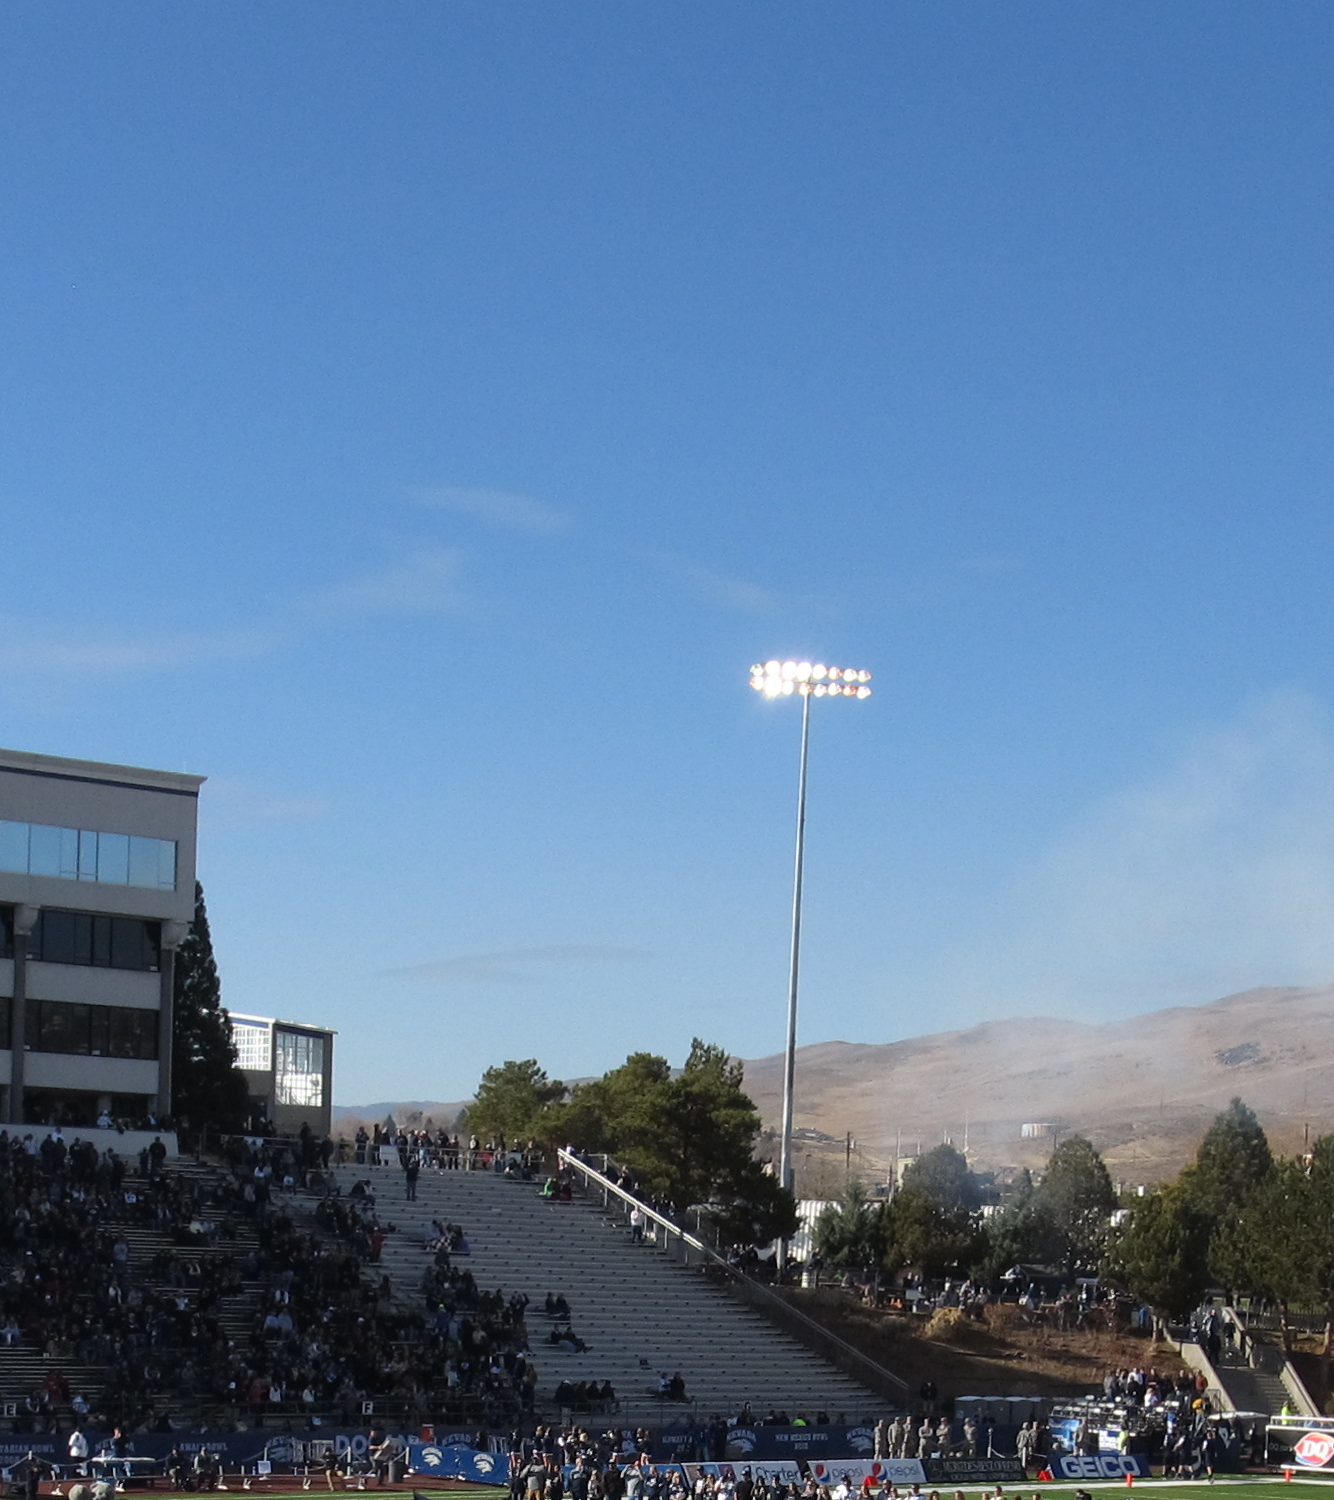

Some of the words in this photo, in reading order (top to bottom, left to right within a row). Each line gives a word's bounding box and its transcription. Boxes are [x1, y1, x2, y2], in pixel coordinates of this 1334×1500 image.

[4, 1403, 16, 1416] E
[363, 1403, 373, 1414] F
[1303, 1440, 1331, 1457] DQ
[755, 1465, 799, 1480] Charter
[831, 1464, 864, 1478] pepsi
[889, 1464, 920, 1477] pepsi
[1059, 1455, 1142, 1478] GEICO
